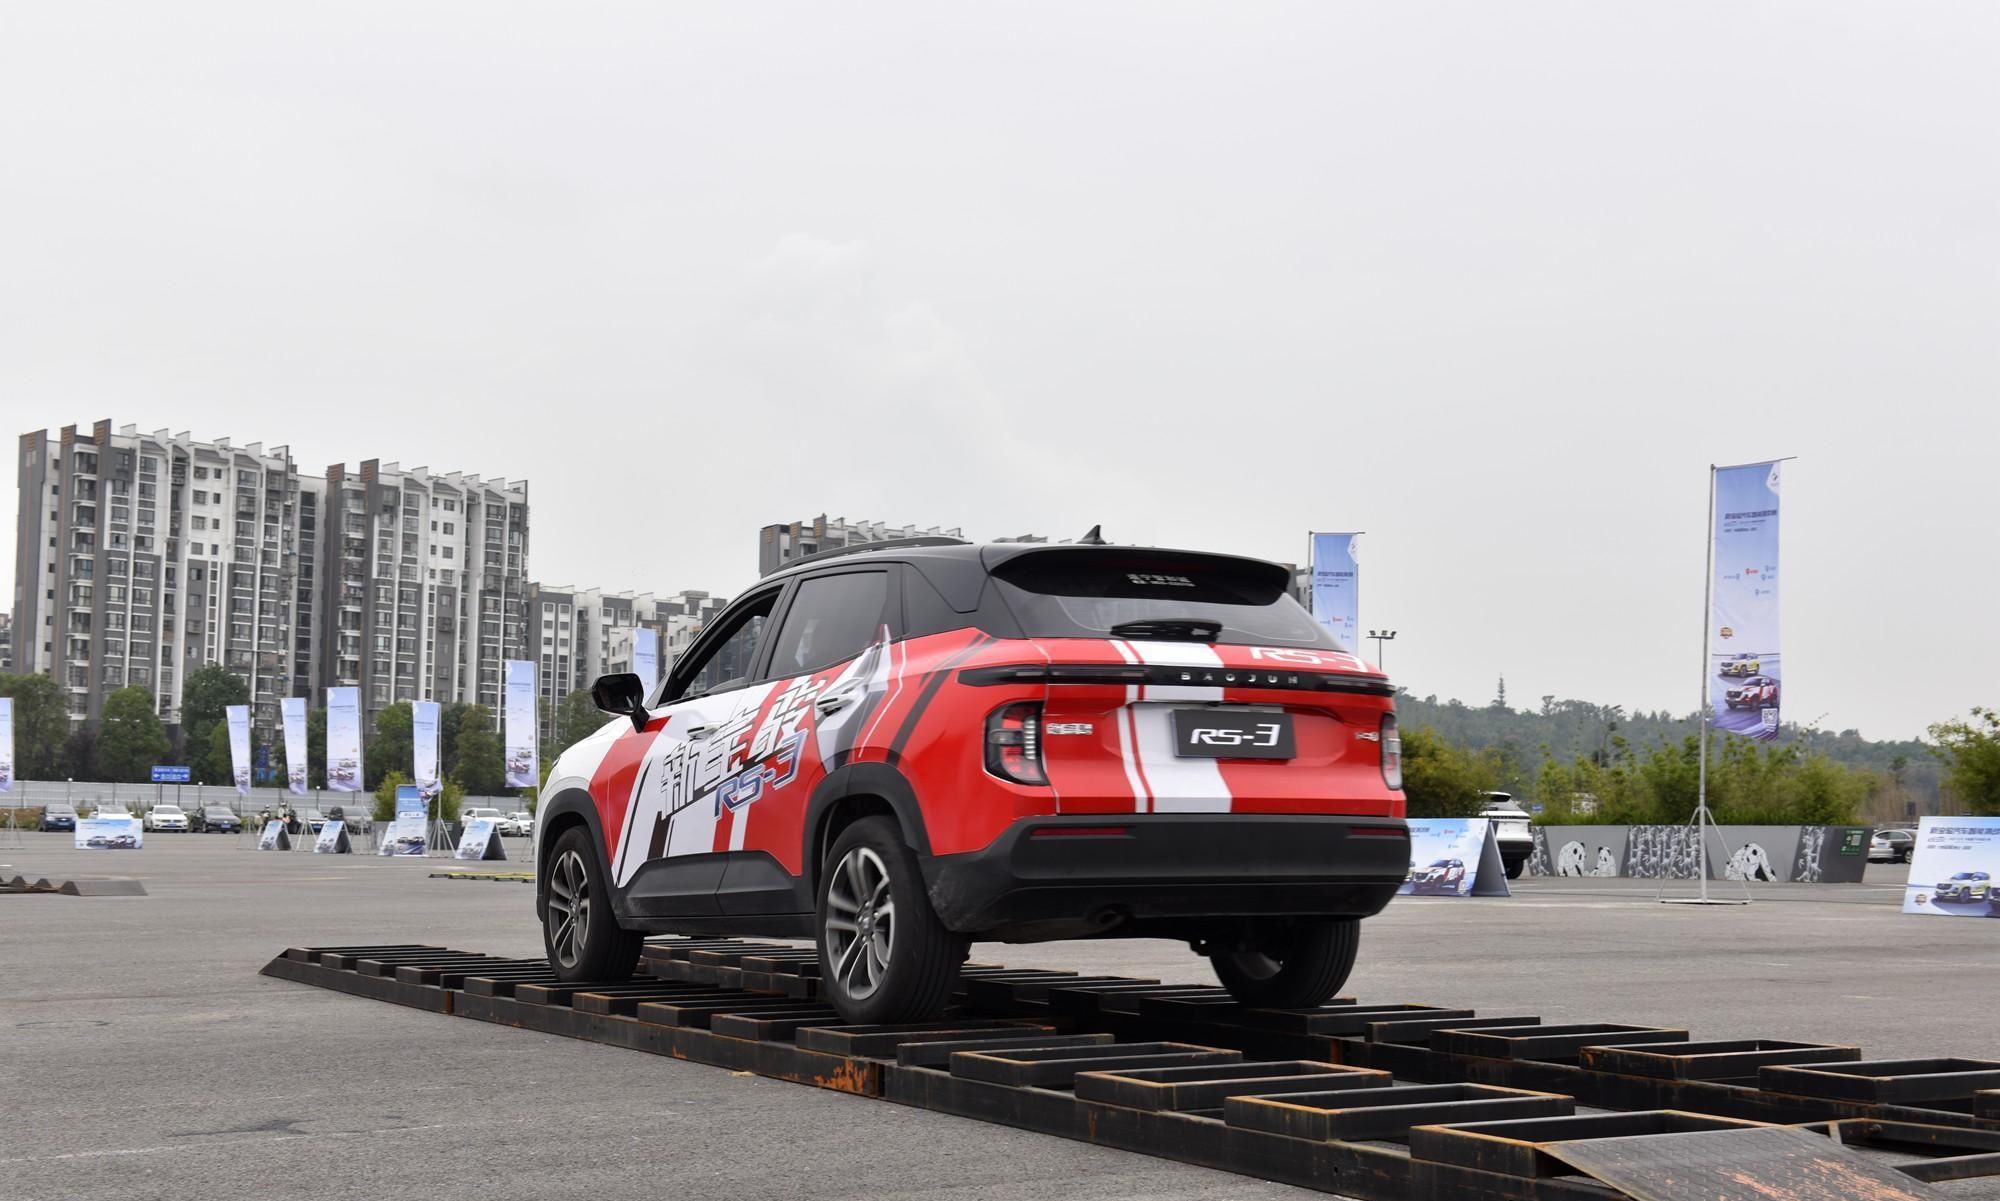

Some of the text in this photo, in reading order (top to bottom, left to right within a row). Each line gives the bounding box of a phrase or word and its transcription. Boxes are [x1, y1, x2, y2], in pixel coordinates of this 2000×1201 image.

[1249, 647, 1369, 672] RS-3
[1181, 672, 1298, 684] BAOJUN
[1190, 723, 1281, 746] RS-3
[713, 728, 809, 820] RS-3
